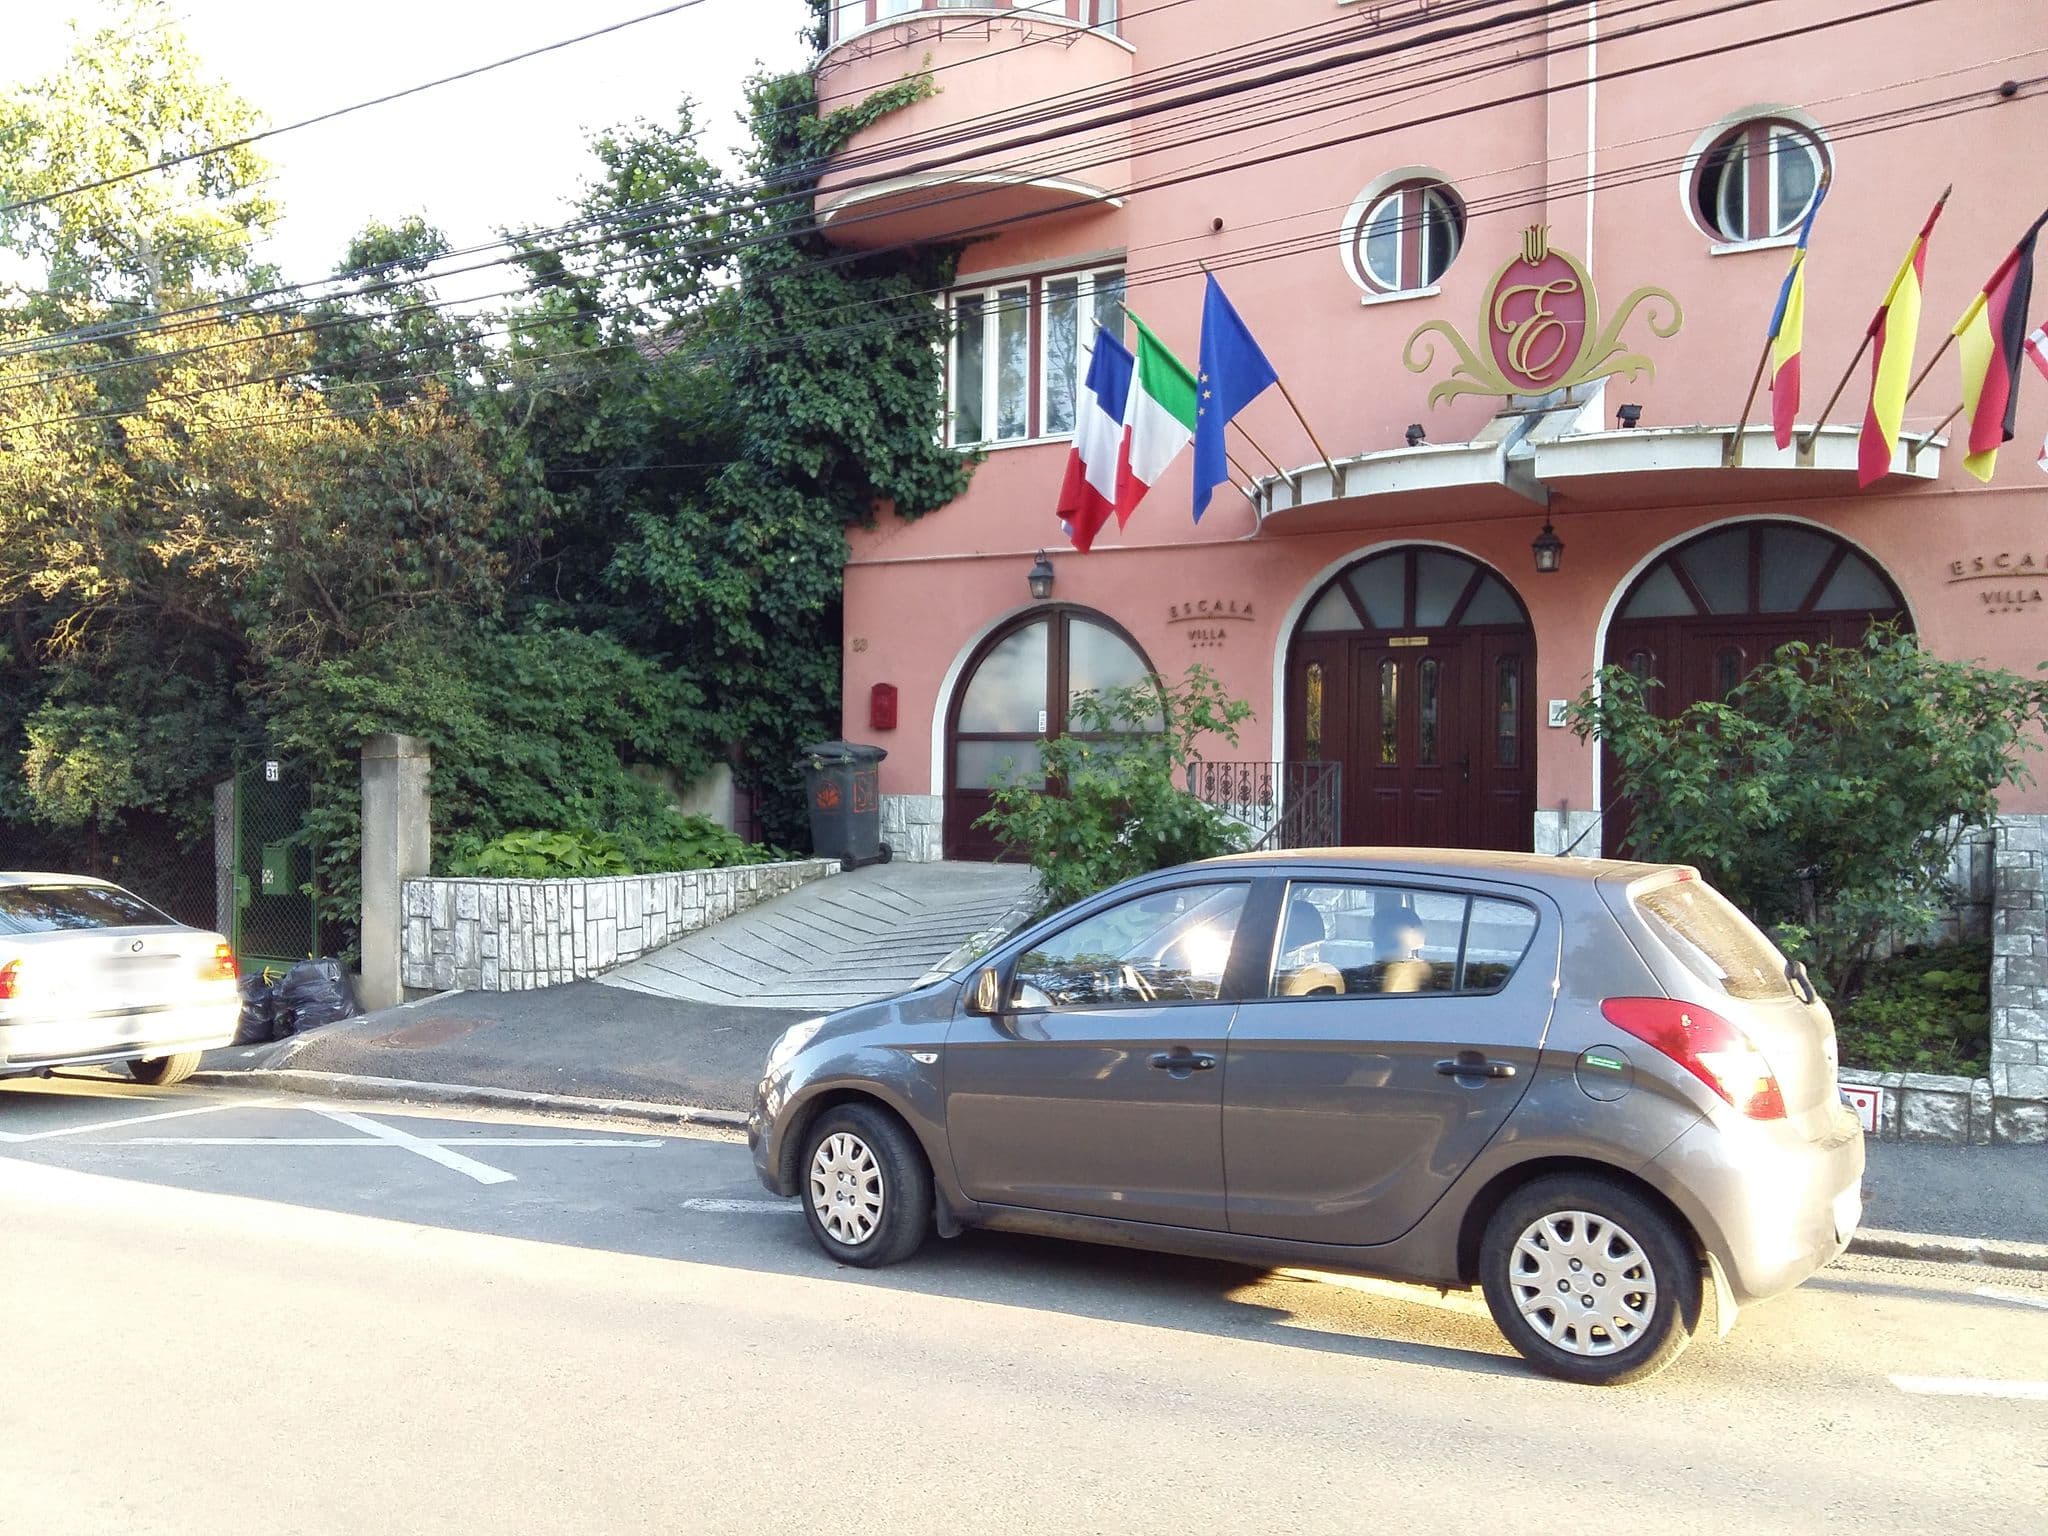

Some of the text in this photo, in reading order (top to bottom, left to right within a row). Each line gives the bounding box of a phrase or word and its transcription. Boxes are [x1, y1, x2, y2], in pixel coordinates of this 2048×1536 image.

[1950, 553, 2048, 576] ESCA
[1981, 591, 2042, 604] VILLA
[1168, 600, 1254, 618] ESCALA
[1188, 629, 1227, 641] VILLA
[267, 768, 277, 778] 31
